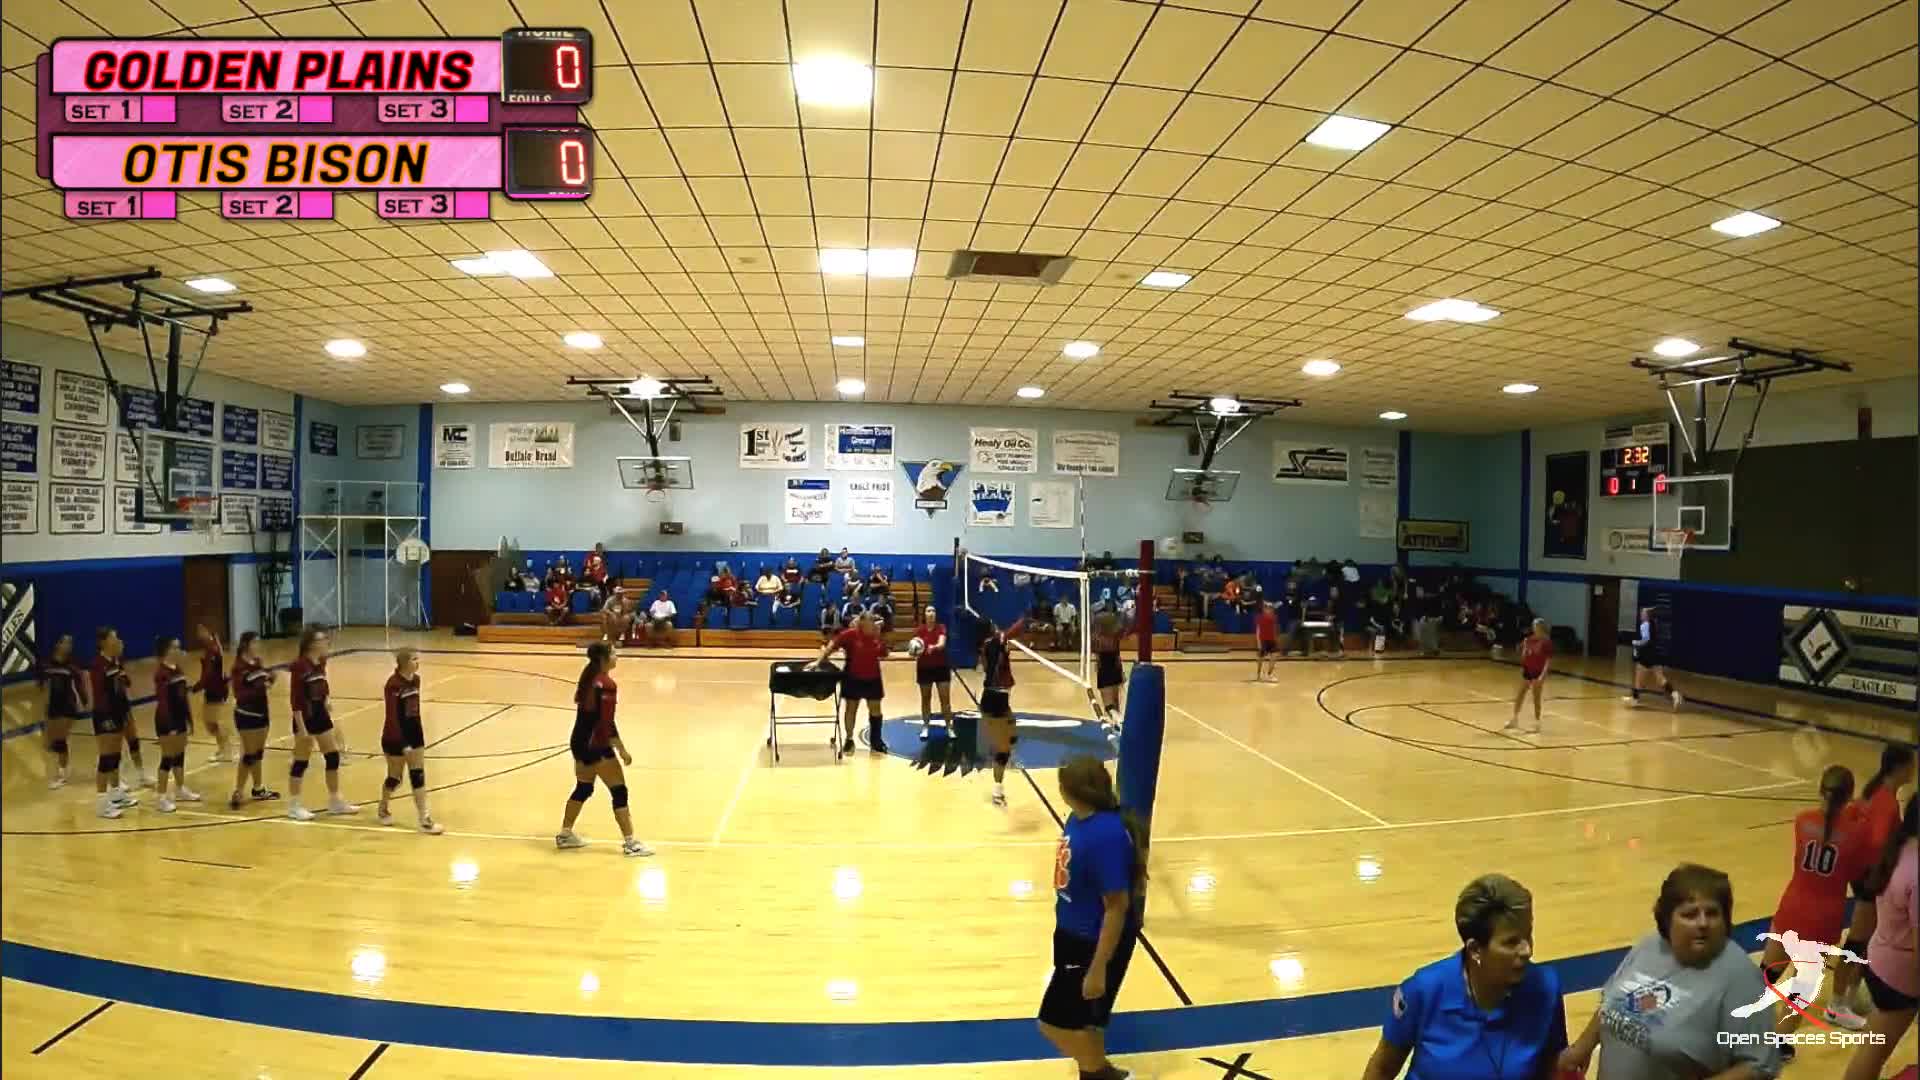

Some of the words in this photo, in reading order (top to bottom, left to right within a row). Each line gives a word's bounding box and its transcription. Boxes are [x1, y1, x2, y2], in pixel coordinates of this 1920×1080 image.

[974, 437, 1001, 450] Healy
[535, 448, 557, 462] Brand
[1624, 446, 1649, 465] 2:32
[1860, 614, 1902, 630] HEALY
[1852, 677, 1897, 695] EAGLES
[1800, 839, 1839, 878] 10
